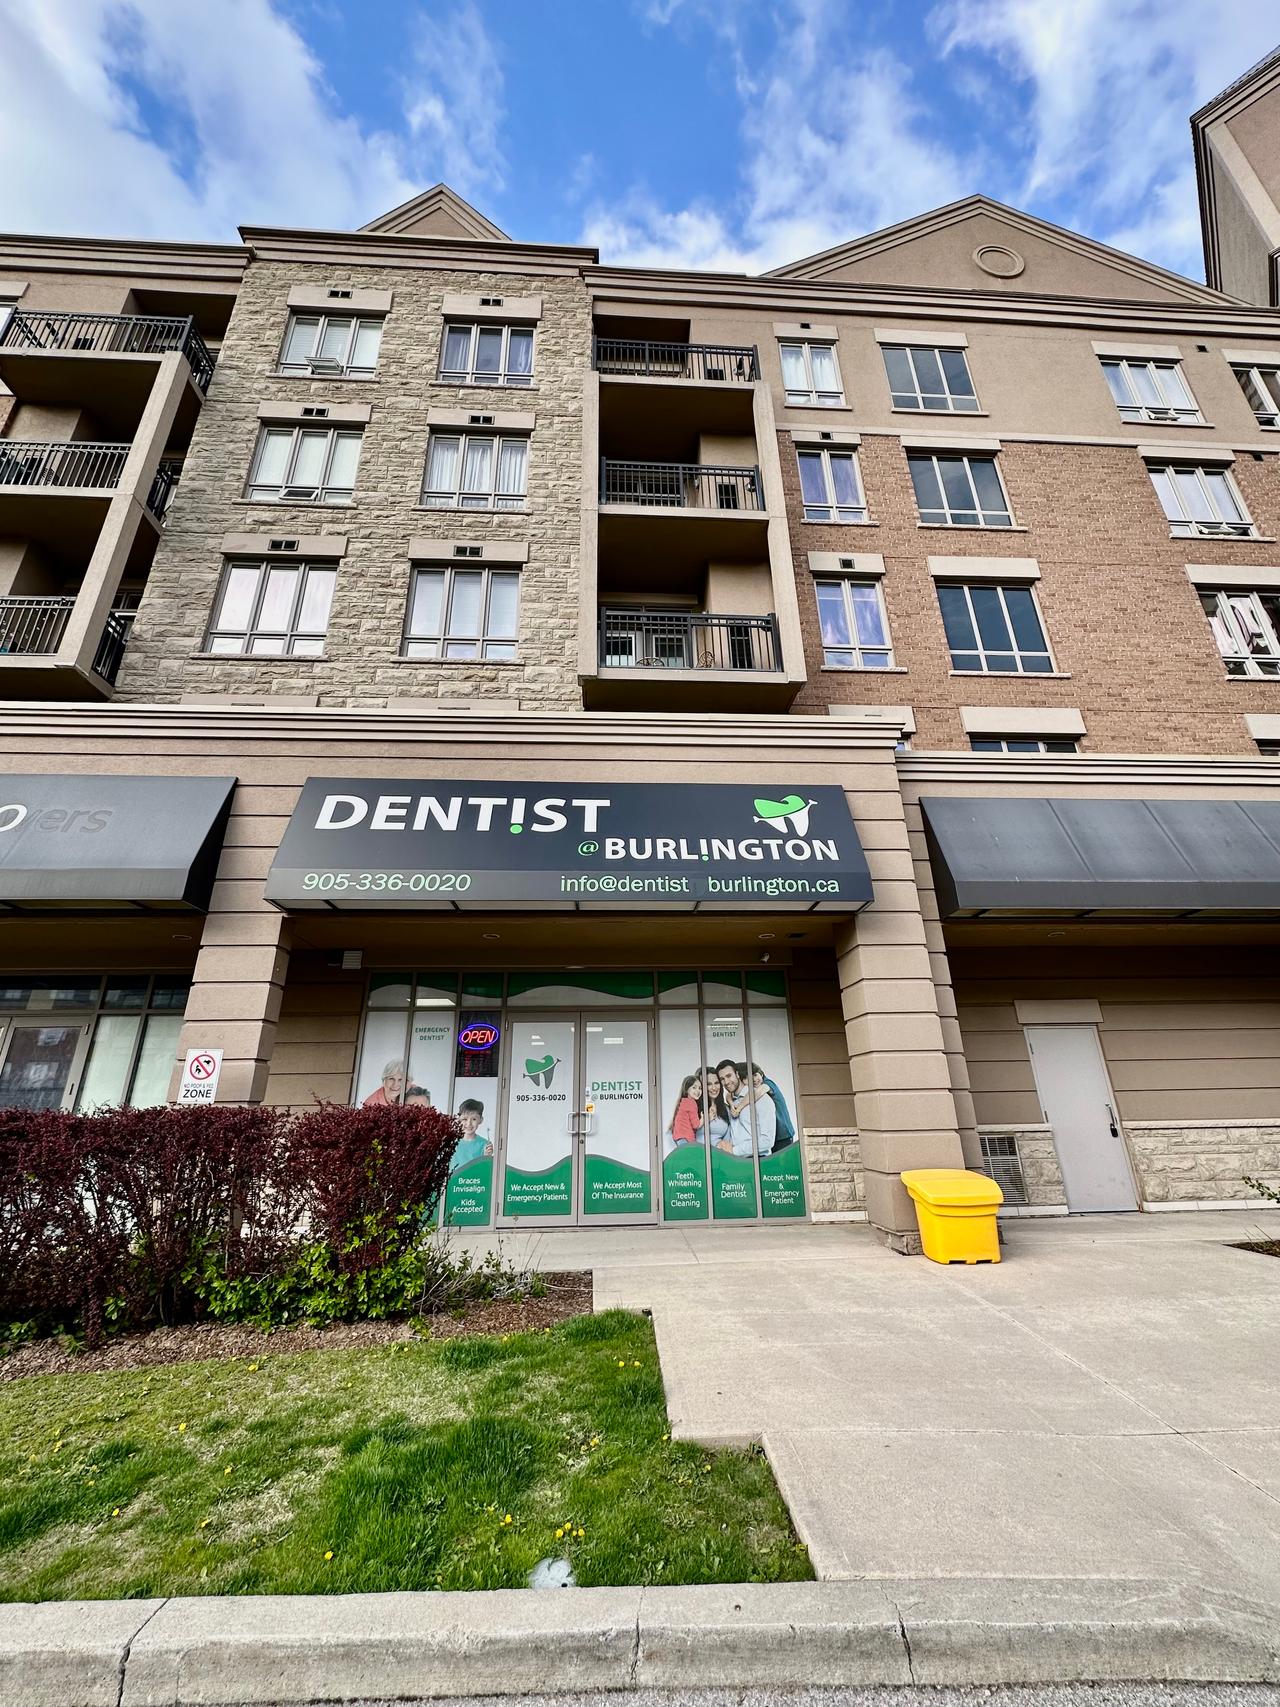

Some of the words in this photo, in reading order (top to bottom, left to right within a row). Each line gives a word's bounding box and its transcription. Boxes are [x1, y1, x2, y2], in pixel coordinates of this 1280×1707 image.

[302, 872, 472, 892] 905-336-0020
[560, 875, 690, 893] info@dentist
[708, 875, 840, 896] burlington.ca
[461, 1030, 496, 1044] OPEN
[183, 1089, 212, 1098] ZONE
[516, 1094, 566, 1102] 905-336-0020
[762, 1174, 784, 1183] Accept
[511, 1183, 521, 1191] We
[522, 1183, 544, 1192] Accept
[560, 1182, 566, 1190] &
[604, 1181, 625, 1190] Accept
[668, 1179, 702, 1188] Whitening
[721, 1182, 745, 1191] Family
[453, 1185, 486, 1194] Invisalign
[721, 1190, 747, 1198] Dentist
[764, 1190, 800, 1198] Emergency
[507, 1194, 542, 1202] Emergency
[543, 1193, 568, 1201] Patients
[601, 1191, 613, 1199] The
[613, 1191, 644, 1199] Insurance
[671, 1199, 701, 1208] Cleaning
[452, 1205, 484, 1214] Accepted
